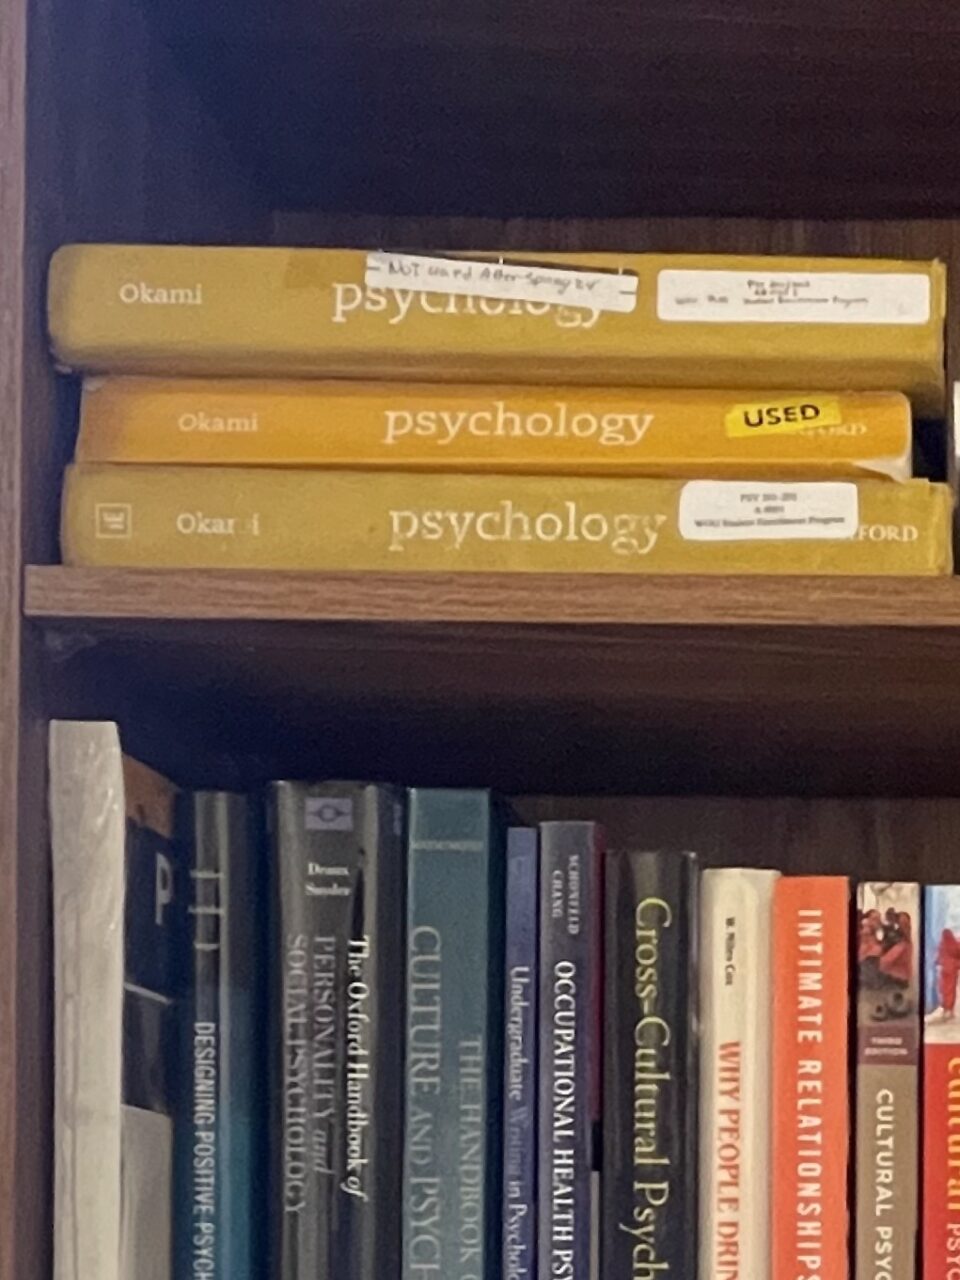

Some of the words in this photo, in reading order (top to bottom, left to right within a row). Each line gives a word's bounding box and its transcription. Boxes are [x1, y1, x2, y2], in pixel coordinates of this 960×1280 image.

[119, 282, 202, 305] Okami
[178, 412, 258, 433] Okami
[382, 402, 655, 445] psychology
[743, 403, 821, 429] USED
[388, 499, 667, 553] psychology
[284, 935, 309, 1032] SOCIAL
[347, 935, 370, 977] The
[797, 908, 823, 1043] INTIMATE
[311, 936, 338, 1119] PERSONALITY
[347, 981, 371, 1056] Oxford
[409, 925, 441, 1097] CULTURE
[507, 965, 531, 1100] Undergraduate
[552, 960, 577, 1143] OCCUPATIONAL
[633, 897, 672, 1166] Cross-Cultural
[194, 1022, 216, 1125] DESIGNING
[346, 1062, 371, 1168] Handbook
[458, 1038, 483, 1098] THE
[718, 1040, 741, 1101] WHY
[194, 1131, 216, 1215] POSITIVE
[283, 1042, 309, 1217] PSYCHOLOGY
[409, 1106, 434, 1165] AND
[717, 1108, 741, 1213] PEOPLE
[875, 1088, 894, 1216] CULTURAL
[340, 1175, 368, 1201] of
[458, 1103, 483, 1264] HANDBOOK
[508, 1180, 530, 1198] in
[552, 1148, 576, 1242] HEALTH
